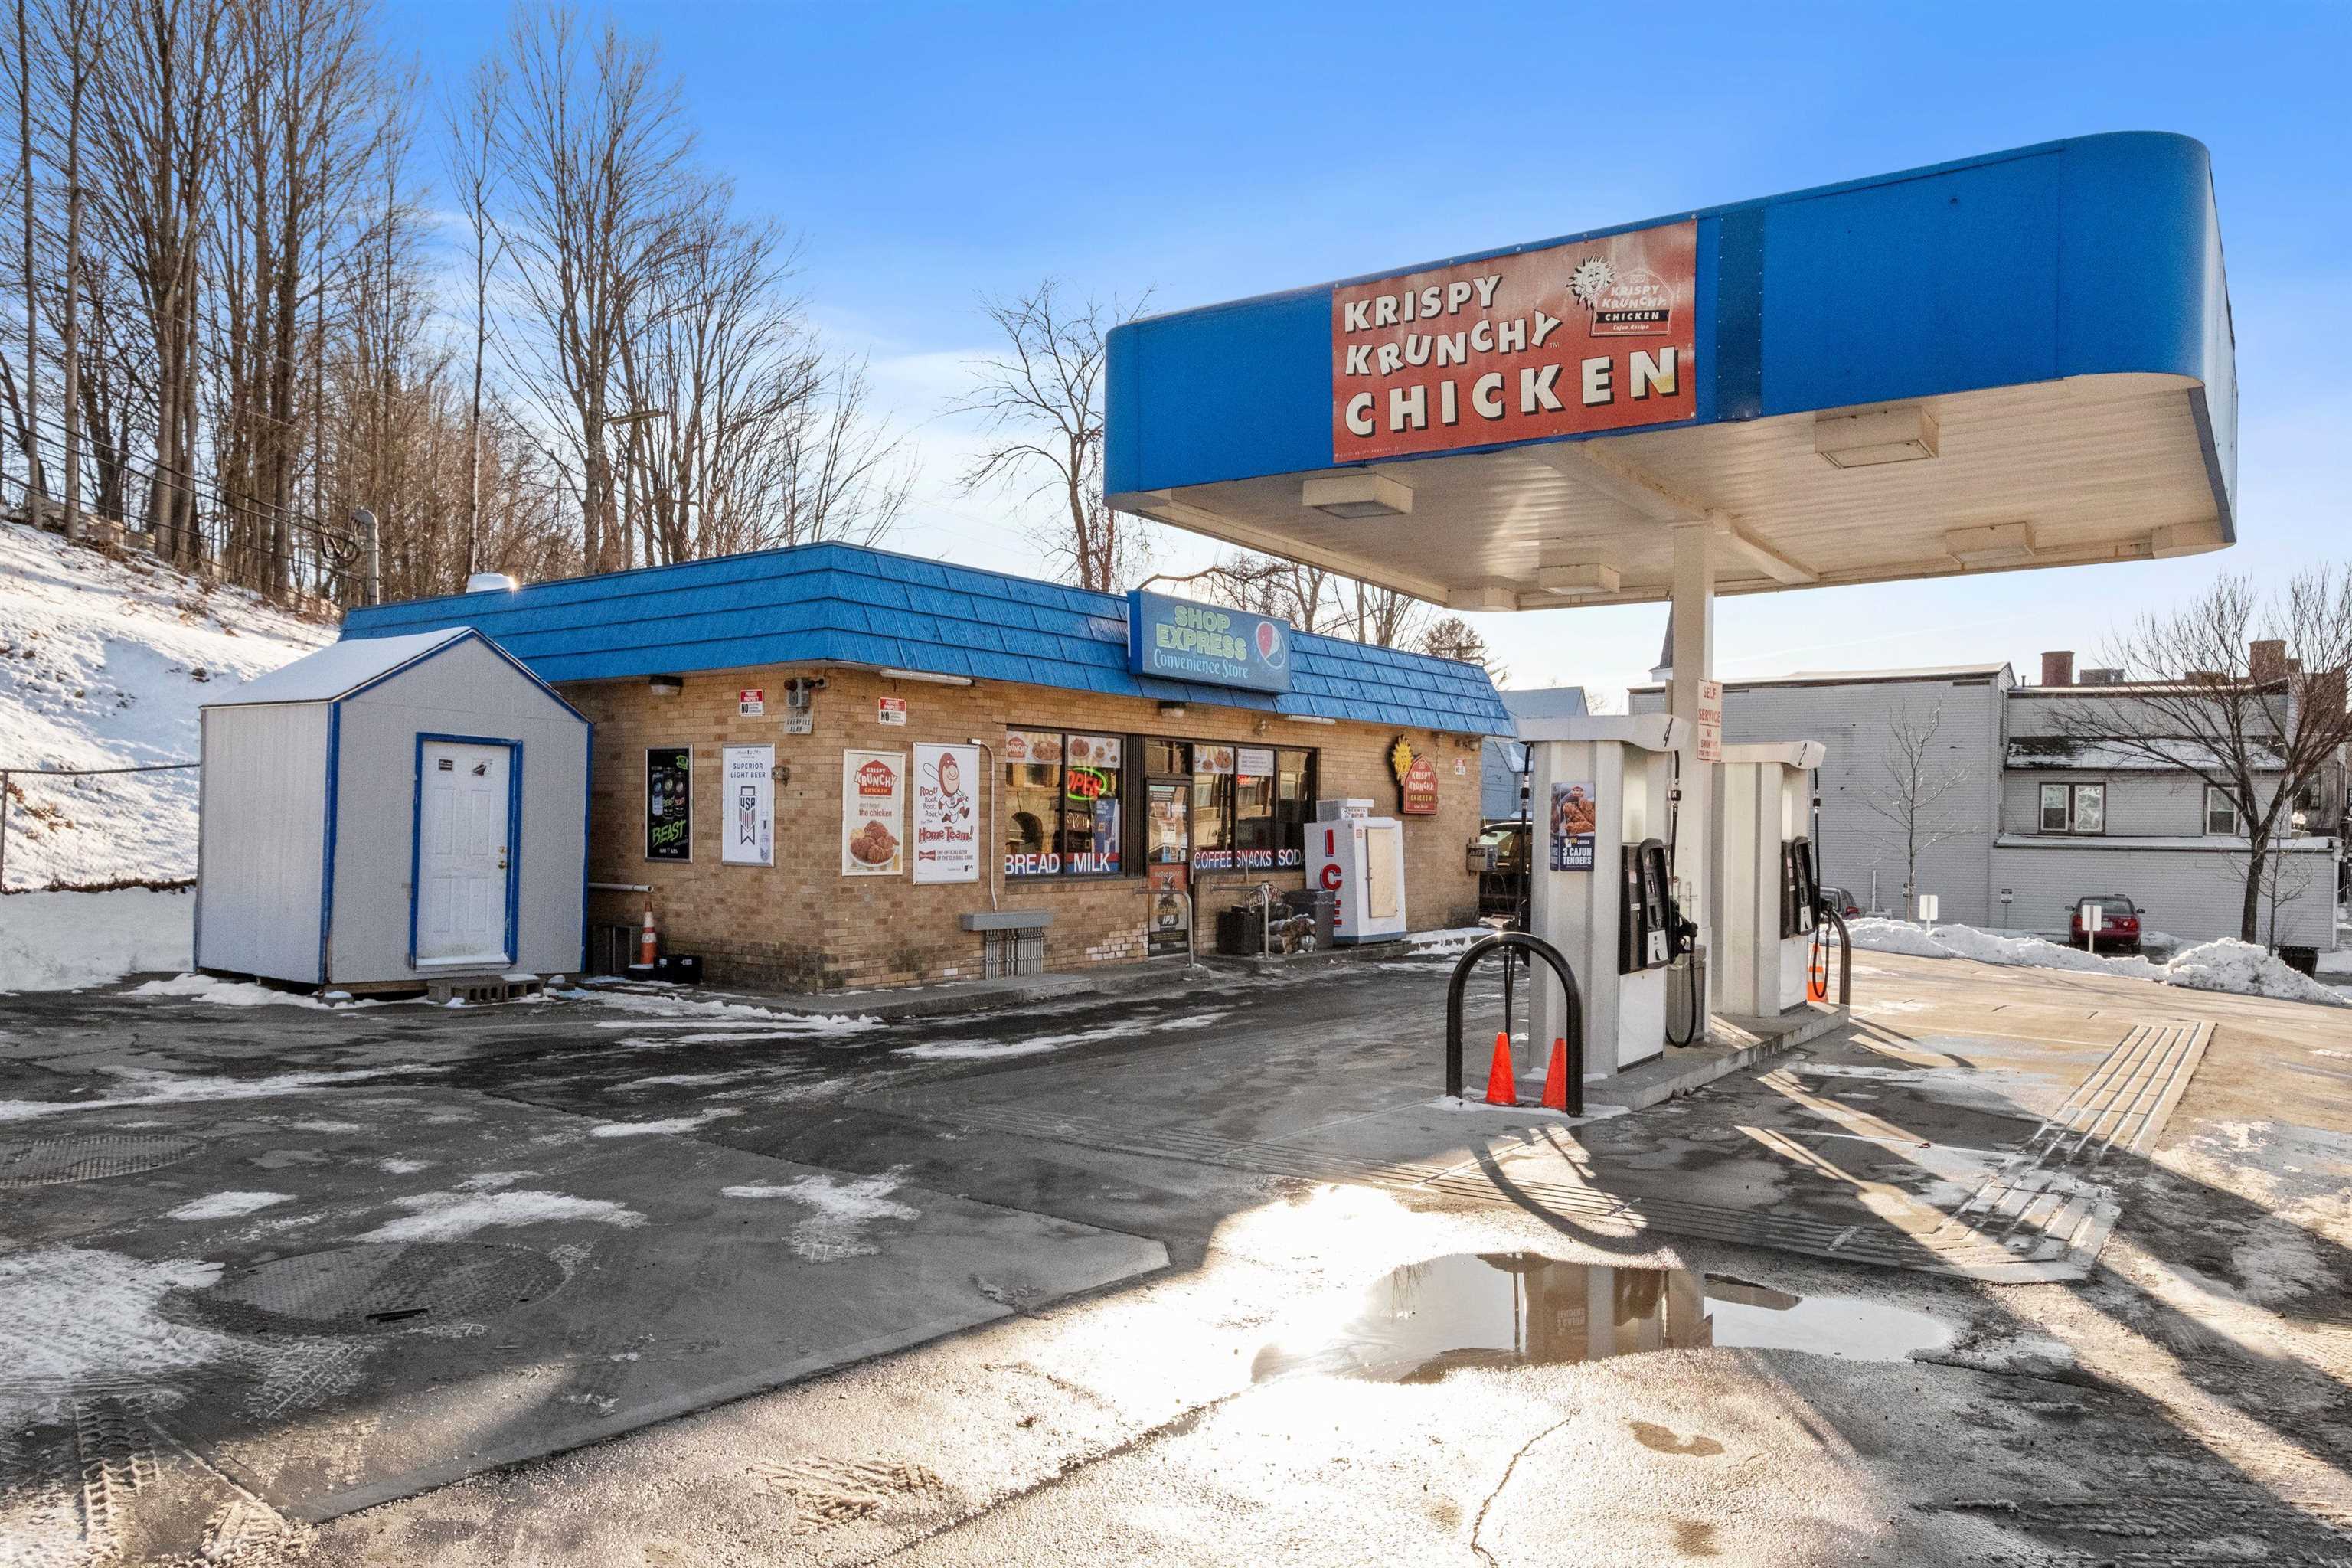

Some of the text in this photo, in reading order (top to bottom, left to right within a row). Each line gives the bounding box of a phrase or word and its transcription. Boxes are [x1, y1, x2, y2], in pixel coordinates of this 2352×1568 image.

[1611, 285, 1660, 296] KRISPY
[1344, 274, 1502, 334] KRISPY
[1602, 296, 1667, 309] KRUNCHY
[1605, 312, 1660, 322] CHICKEN
[1346, 310, 1562, 376] KRUNCHY
[1345, 346, 1681, 439] CHICKEN
[1174, 605, 1230, 633] SHOP
[1156, 622, 1247, 661] EXPRESS
[1154, 648, 1249, 679] Convenience Store
[1704, 686, 1716, 699] SELF
[741, 704, 749, 714] NO
[881, 711, 890, 721] NO
[1698, 709, 1720, 724] SERVICE
[854, 770, 897, 788] KRUNCHY
[1412, 771, 1432, 780] KRISPY
[1068, 770, 1102, 797] OPEN
[1409, 781, 1434, 791] KRUNCHY
[740, 797, 756, 811] USA
[870, 808, 892, 817] chicken
[652, 819, 687, 848] BEAST
[919, 825, 974, 843] Home Team!
[1563, 848, 1568, 856] 3
[1569, 848, 1592, 856] CAJUN
[1005, 852, 1110, 874] BREAD MILK
[1194, 851, 1233, 869] COFFEE
[1236, 850, 1272, 867] SNACKS
[1563, 856, 1592, 865] TENDERS
[1163, 916, 1174, 925] IPA
